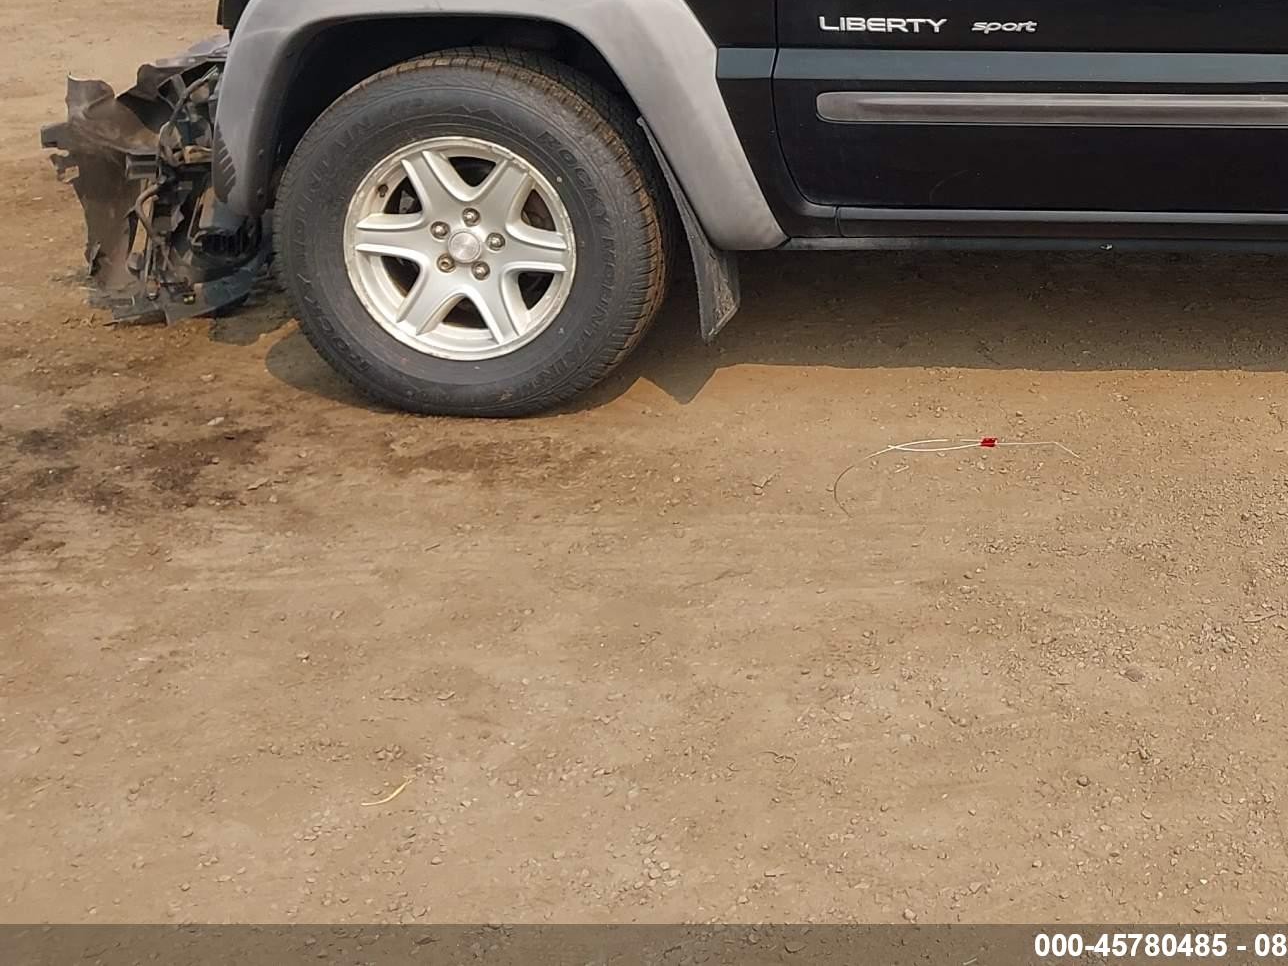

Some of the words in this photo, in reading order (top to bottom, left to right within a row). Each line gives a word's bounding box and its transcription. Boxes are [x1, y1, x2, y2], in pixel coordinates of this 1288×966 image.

[819, 16, 947, 33] LIBERTY
[971, 20, 1037, 34] sport
[536, 130, 610, 228] ROCKY
